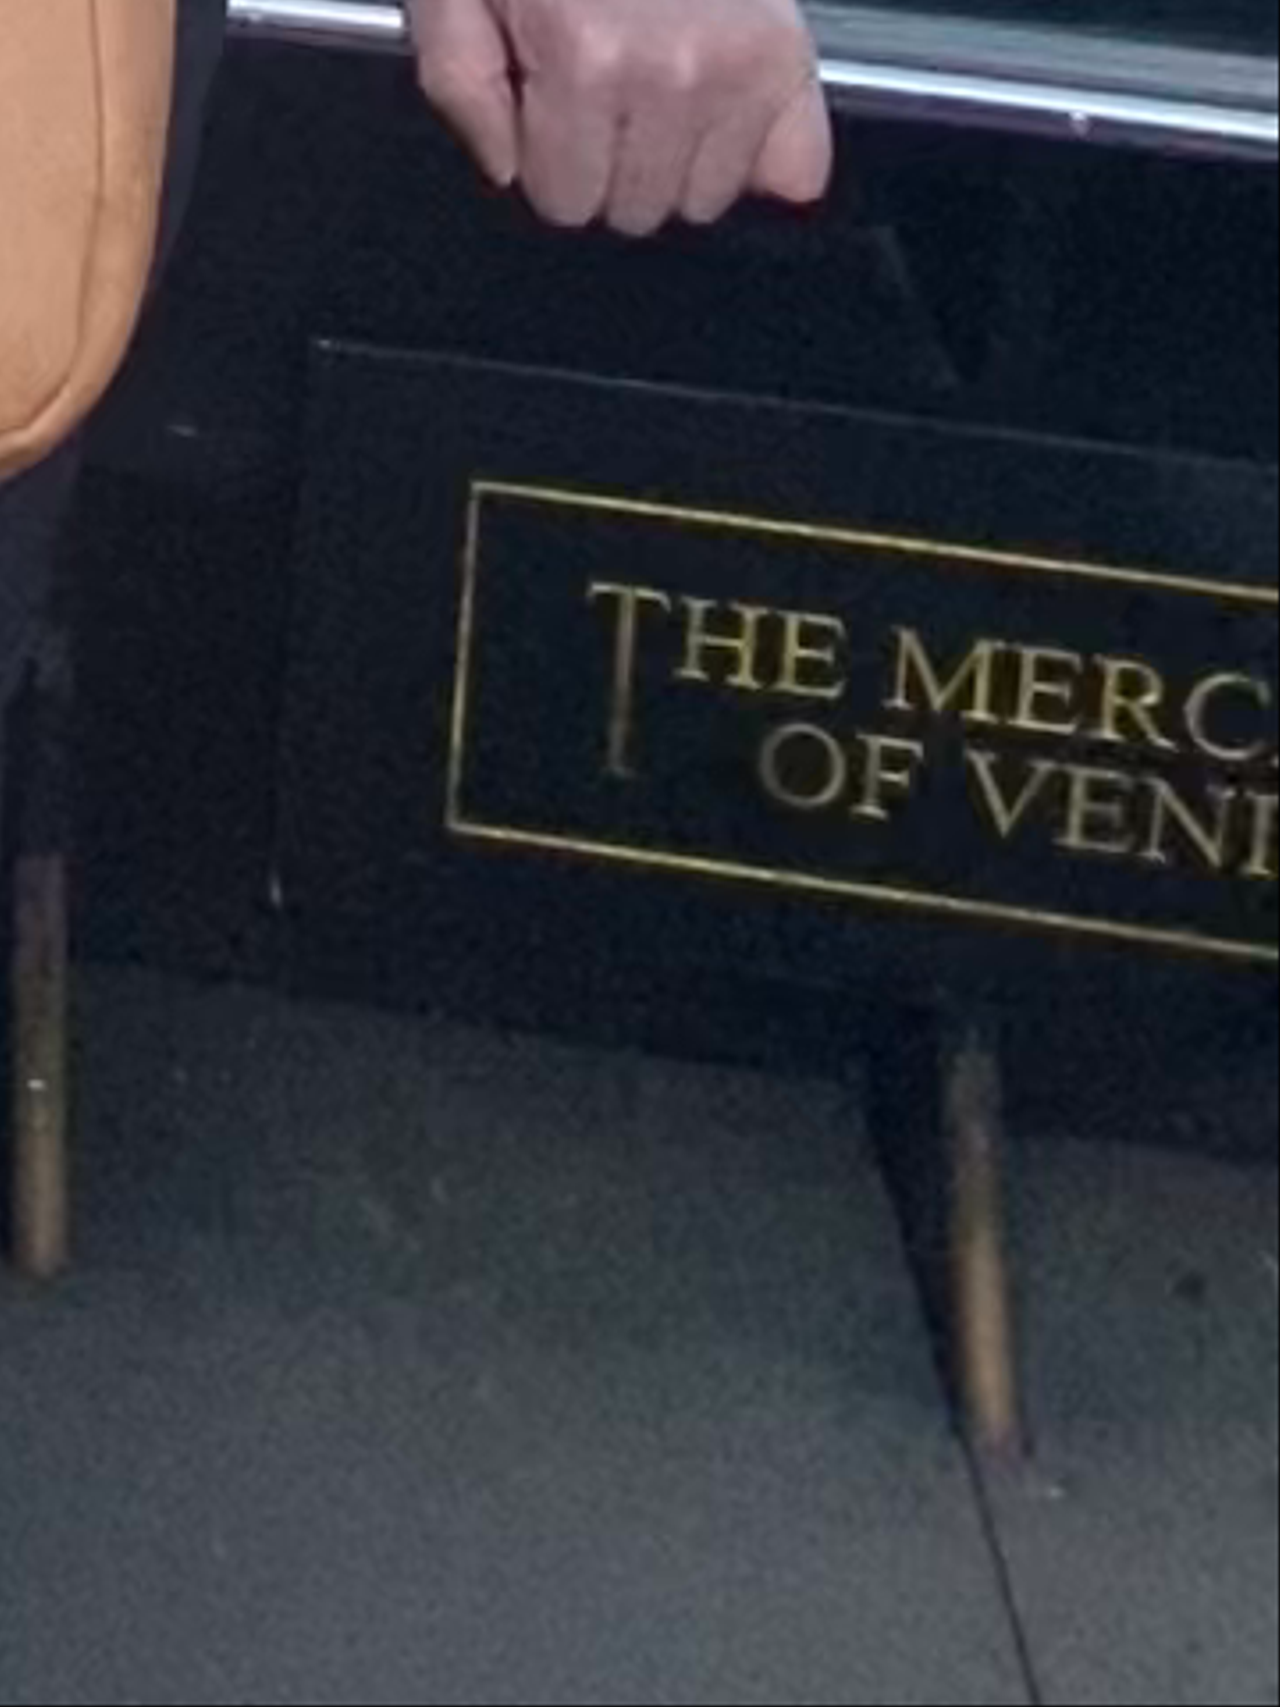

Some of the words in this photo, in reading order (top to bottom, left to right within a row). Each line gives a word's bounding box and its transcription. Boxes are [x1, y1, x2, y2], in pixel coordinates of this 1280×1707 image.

[587, 581, 846, 778] THE
[882, 624, 1279, 768] MERC
[758, 722, 925, 821] OF
[964, 745, 1279, 876] VENI
